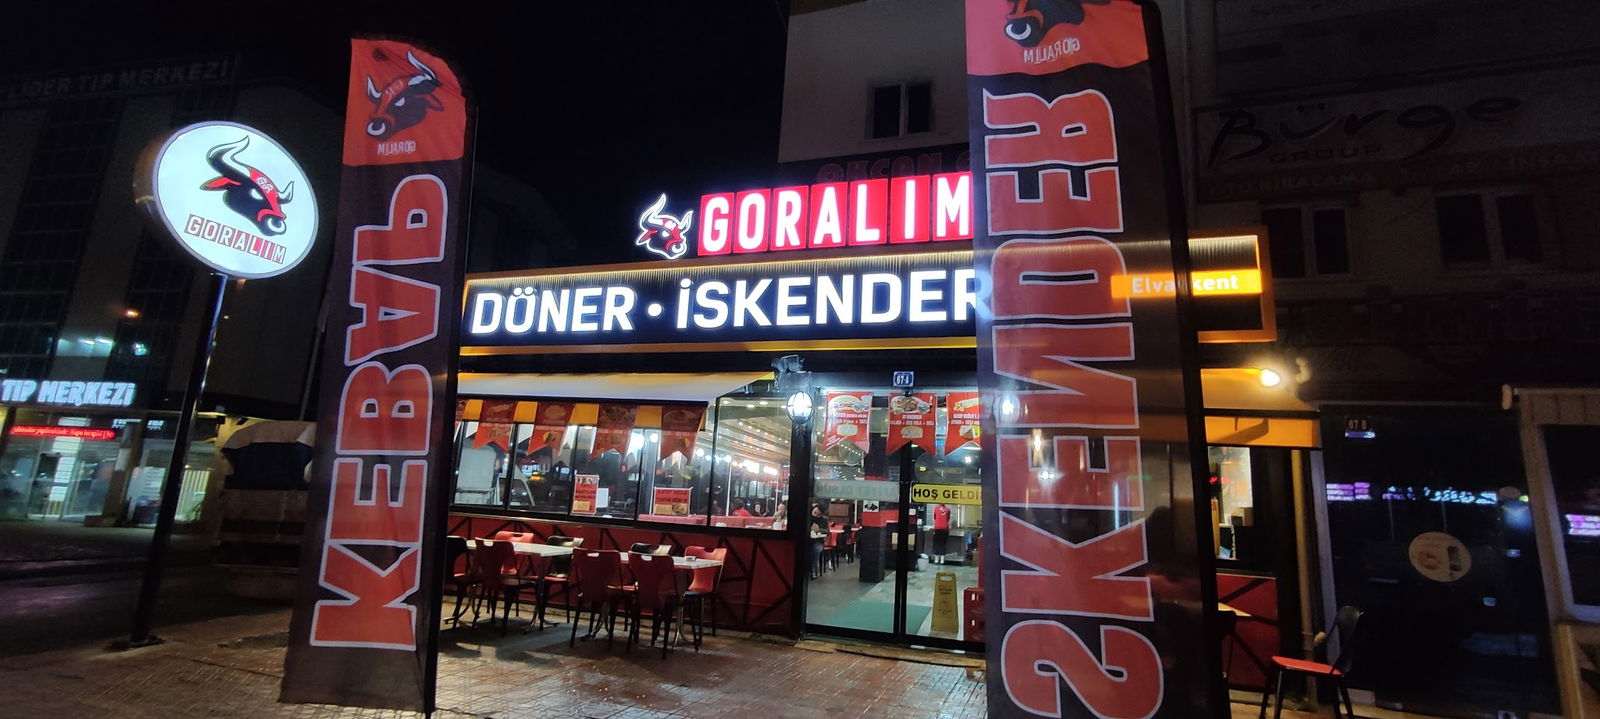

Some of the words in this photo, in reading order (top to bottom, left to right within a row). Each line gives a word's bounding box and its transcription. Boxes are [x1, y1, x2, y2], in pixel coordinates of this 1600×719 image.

[1208, 97, 1522, 168] Bürge
[1269, 144, 1382, 165] GROUP
[703, 174, 973, 253] GORALIM
[186, 215, 287, 264] GORALIM
[471, 286, 635, 334] DÖNER
[676, 267, 993, 330] İSKENDER
[2, 379, 37, 402] TIP
[913, 488, 938, 500] HOŞ
